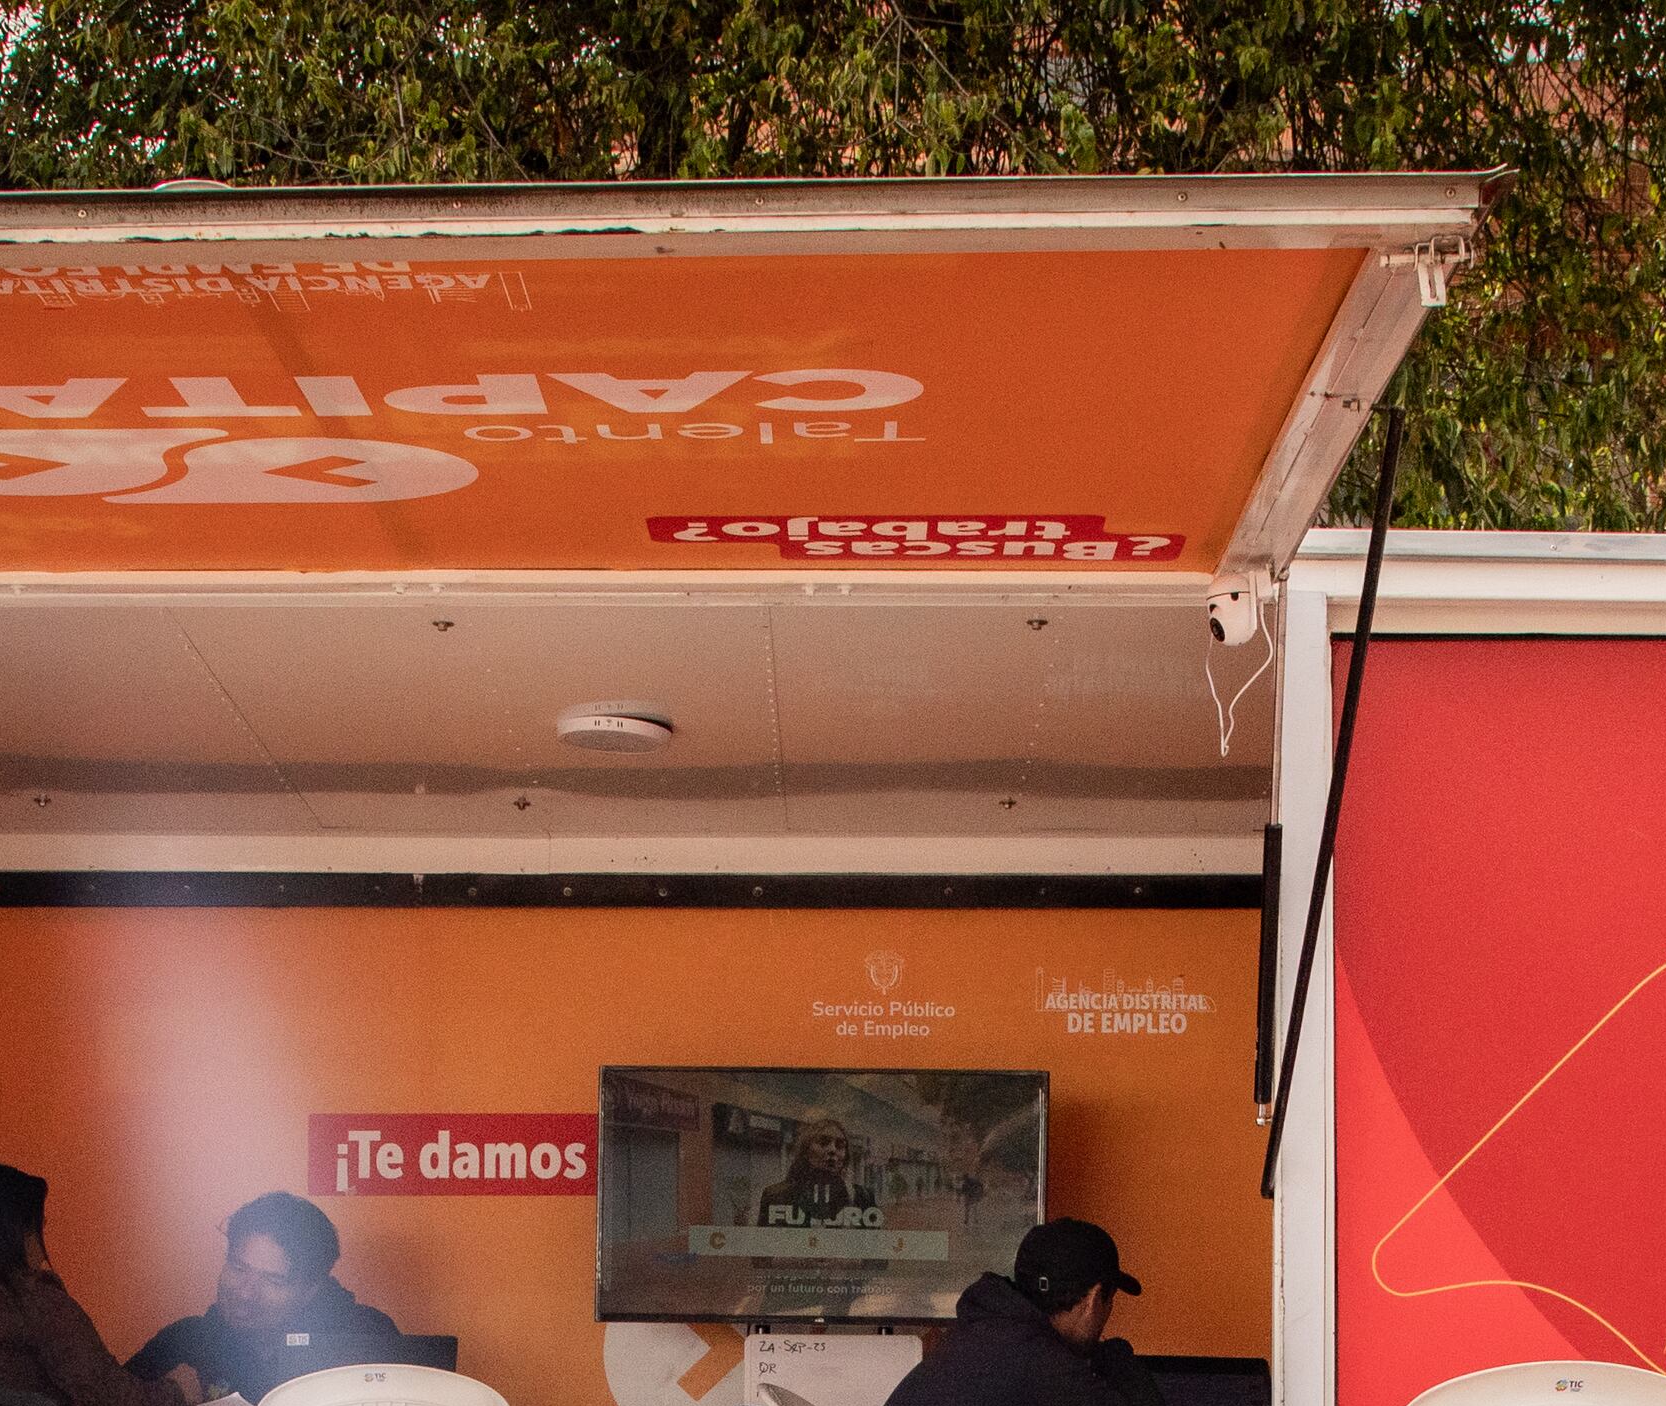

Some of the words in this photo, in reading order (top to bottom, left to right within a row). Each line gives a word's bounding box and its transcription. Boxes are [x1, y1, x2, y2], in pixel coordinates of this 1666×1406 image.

[464, 420, 927, 445] Talento
[672, 516, 1072, 542] trabajo?
[802, 536, 1172, 560] ¿Buscas
[812, 1001, 884, 1018] Servicio
[889, 999, 956, 1018] Público
[1044, 993, 1120, 1011] AGENCIA
[1122, 993, 1207, 1011] DISTRITAL
[835, 1020, 859, 1037] de
[864, 1021, 931, 1040] Empleo
[1067, 1013, 1095, 1034] DE
[1100, 1013, 1188, 1034] EMPLEO
[336, 1130, 405, 1193] ¡Te
[419, 1130, 588, 1180] damos
[788, 1283, 824, 1293] futuro
[827, 1286, 848, 1294] con
[1569, 1380, 1584, 1388] TIC
